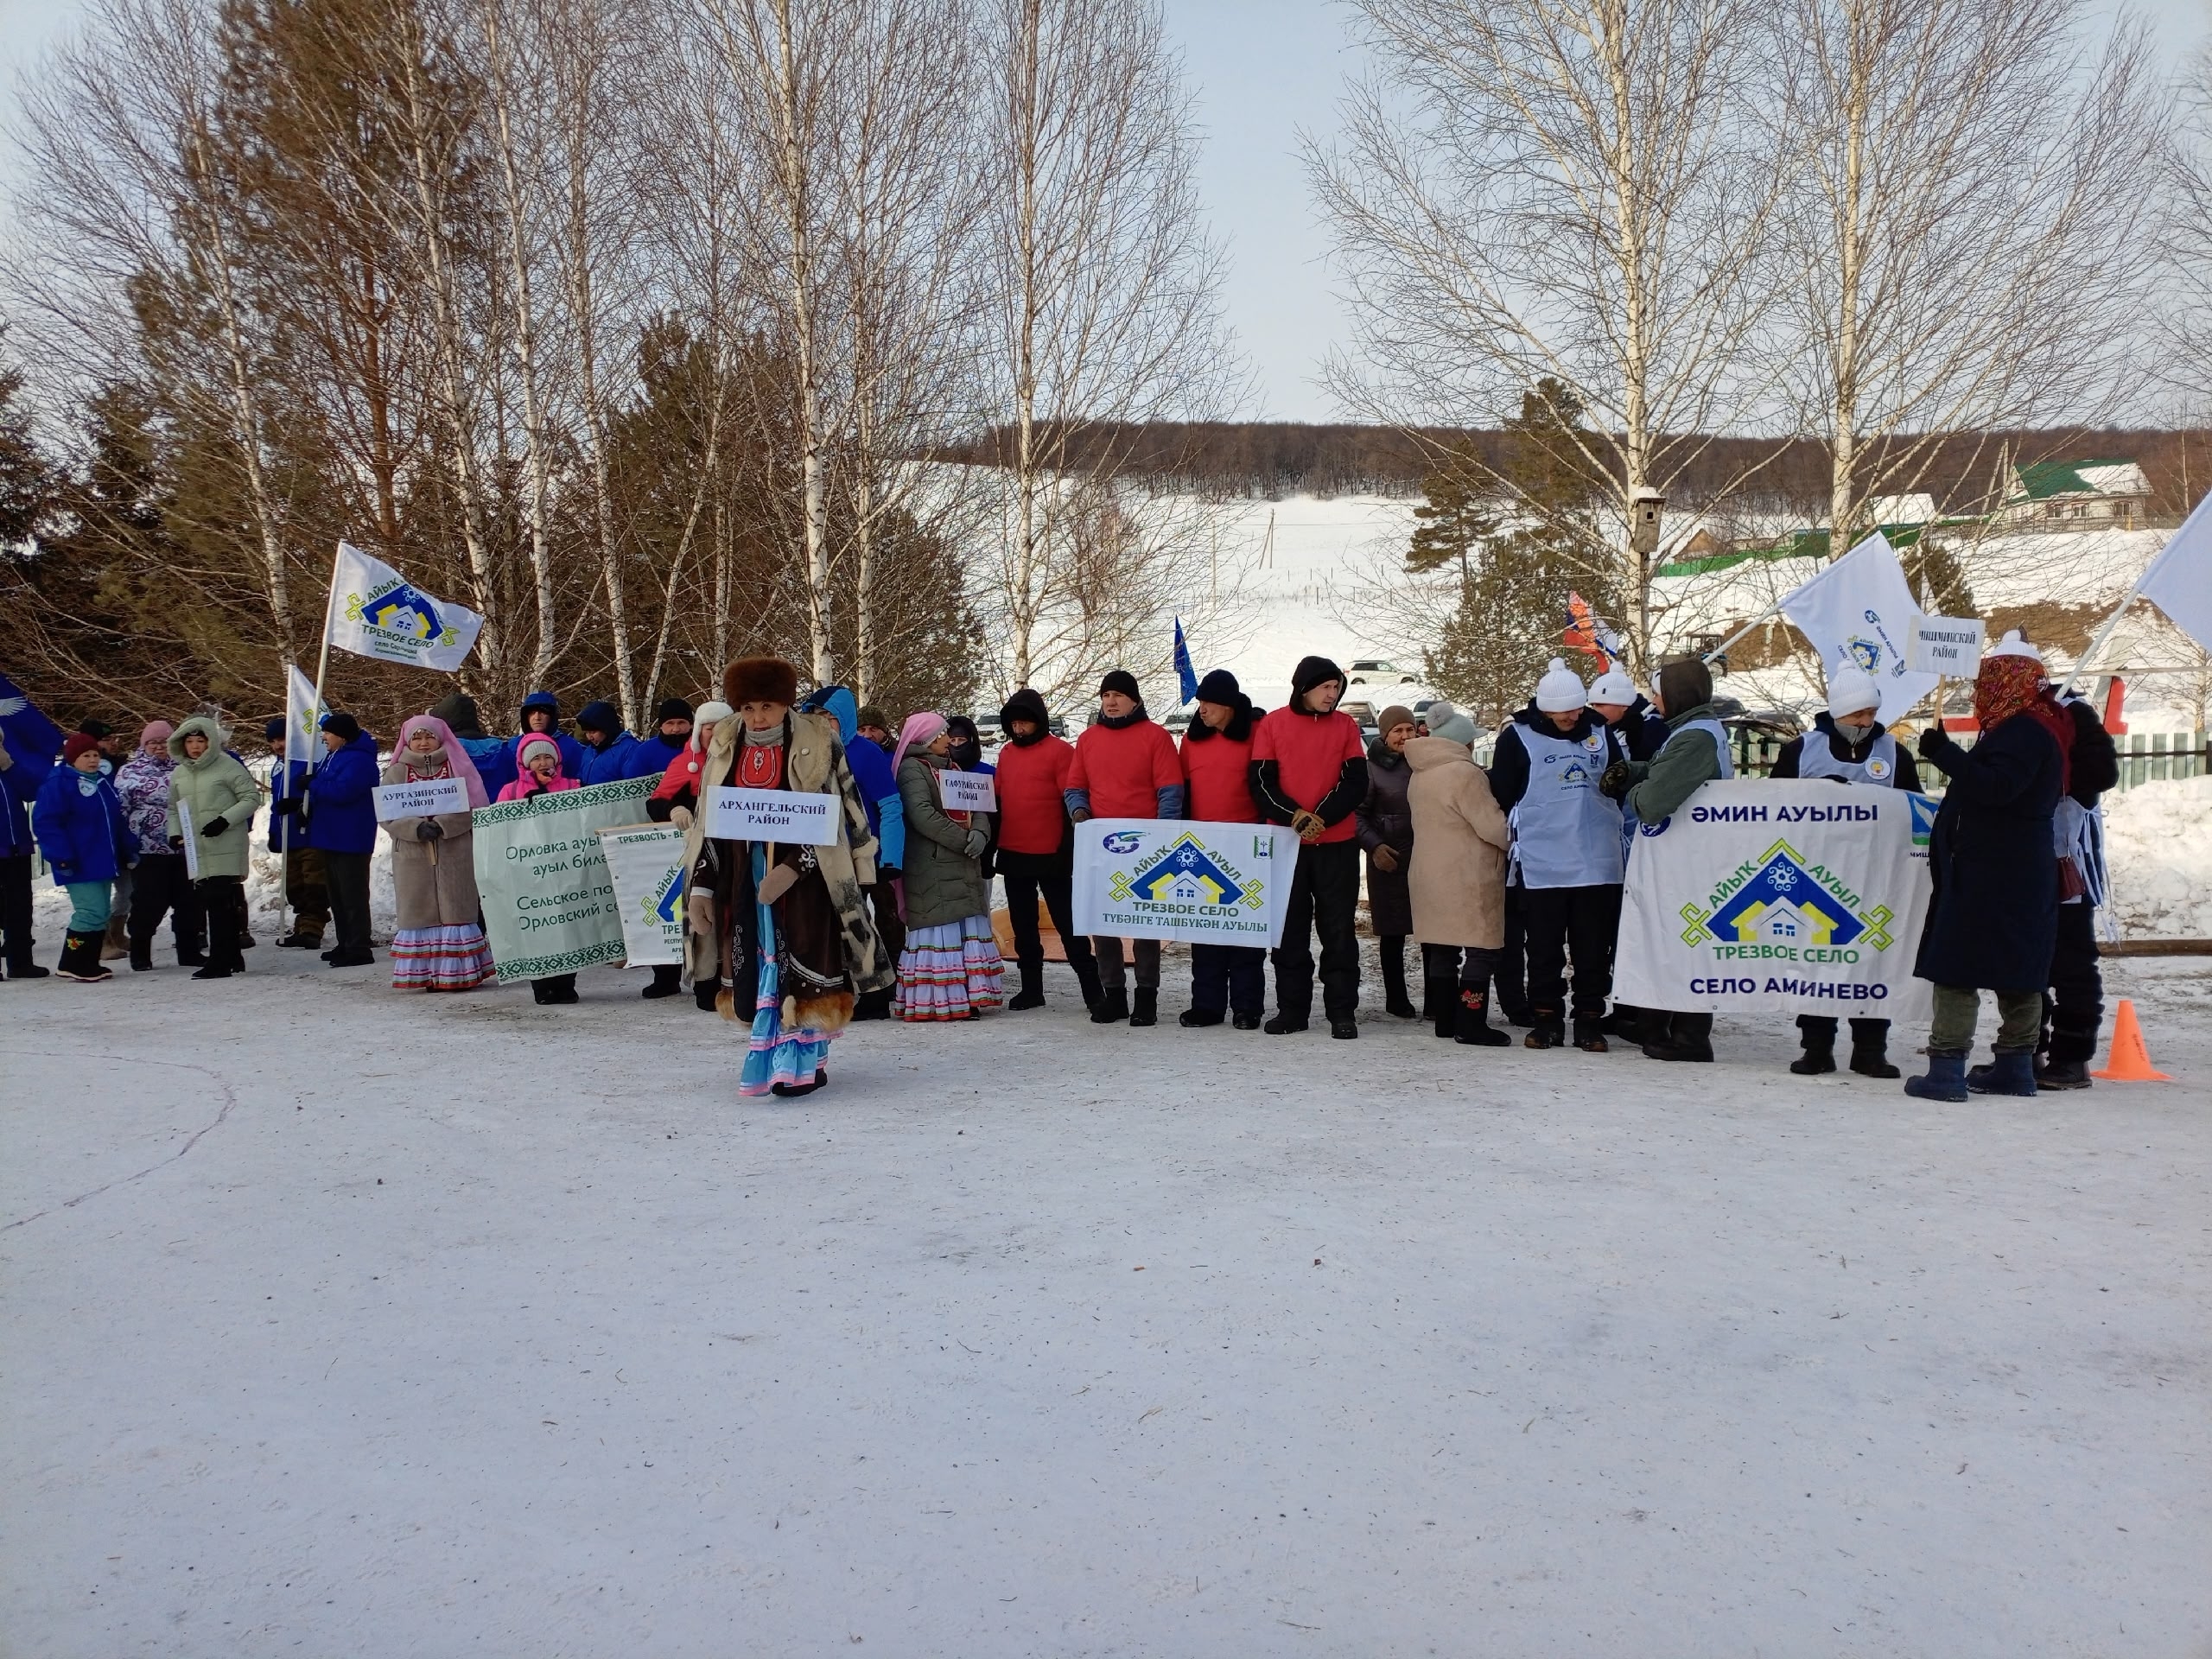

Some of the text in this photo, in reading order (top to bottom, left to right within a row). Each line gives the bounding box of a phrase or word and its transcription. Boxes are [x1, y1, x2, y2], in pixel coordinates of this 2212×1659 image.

[361, 624, 435, 649] ТРЕЗВОЕ СЕЛО
[1919, 630, 1976, 645] ЧИШМИНСКИЙ
[1932, 645, 1958, 658] РАЙОН
[382, 785, 458, 802] АУРГАЗИНСКИЙ
[957, 791, 978, 801] РАЙОН
[402, 798, 435, 809] РАЙОН
[718, 800, 827, 815] АРХАНГЕЛЬСКИЙ
[747, 814, 790, 825] РАЙОН
[1691, 804, 1878, 822] ӘМИН АУЫЛЫ
[617, 831, 667, 844] ТРЕЗВОСТЬ
[505, 841, 568, 862] Орловка
[533, 861, 569, 878] ауыл
[1206, 849, 1243, 880] АУЫЛ
[1808, 864, 1861, 909] АУЫЛ
[517, 890, 589, 910] Сельское
[519, 903, 601, 932] Орловский
[1132, 901, 1239, 918] ТРЕЗВОЕ СЕЛО
[1103, 912, 1268, 932] ТҮБӘНГЕ ТАШБҮКӘН АУЫЛЫ
[1713, 944, 1859, 963] ТРЕЗВОЕ СЕЛО
[1690, 978, 1888, 1000] СЕЛО АМИНЕВО
